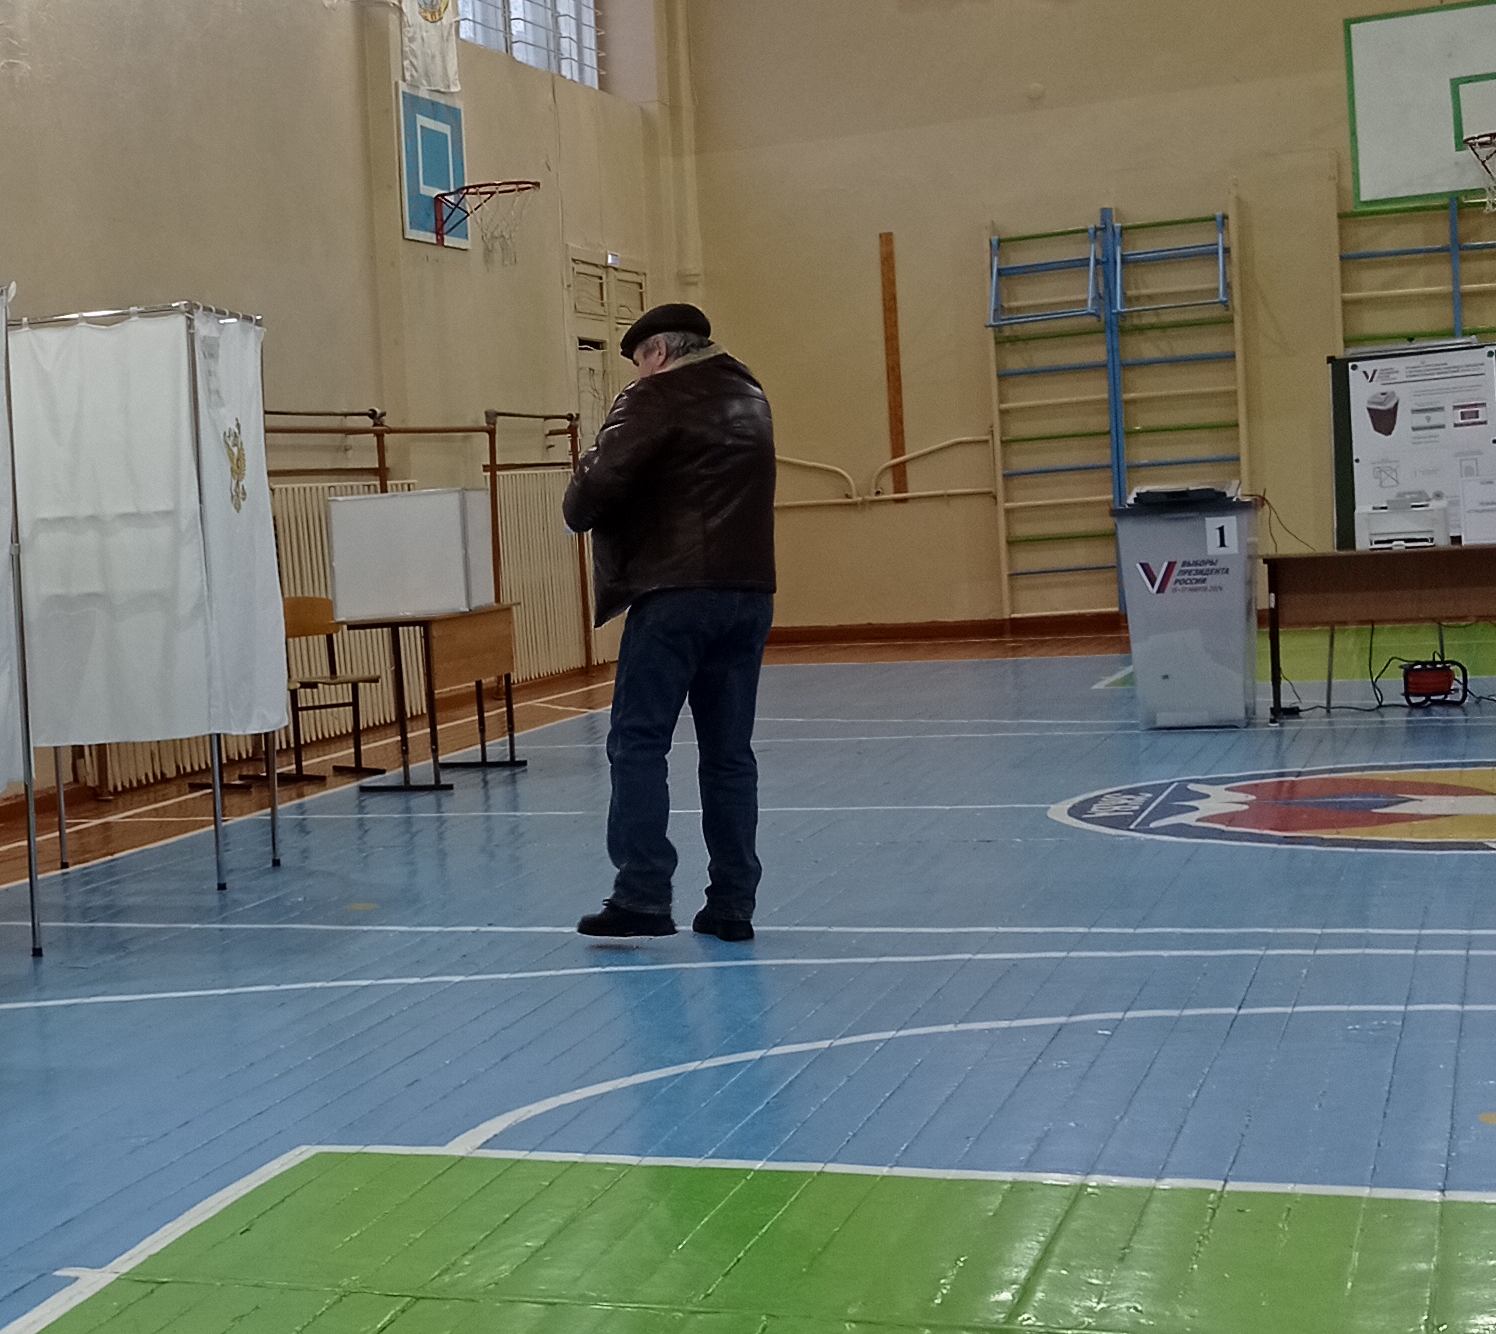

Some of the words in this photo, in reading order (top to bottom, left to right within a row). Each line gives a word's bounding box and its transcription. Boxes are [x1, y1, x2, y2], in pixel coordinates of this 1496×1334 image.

[1214, 524, 1228, 548] 1
[1181, 558, 1218, 568] ВЫБОРЫ
[1176, 567, 1230, 576] ПРЕЗИДЕНТА
[1174, 577, 1208, 586] РОССИИ
